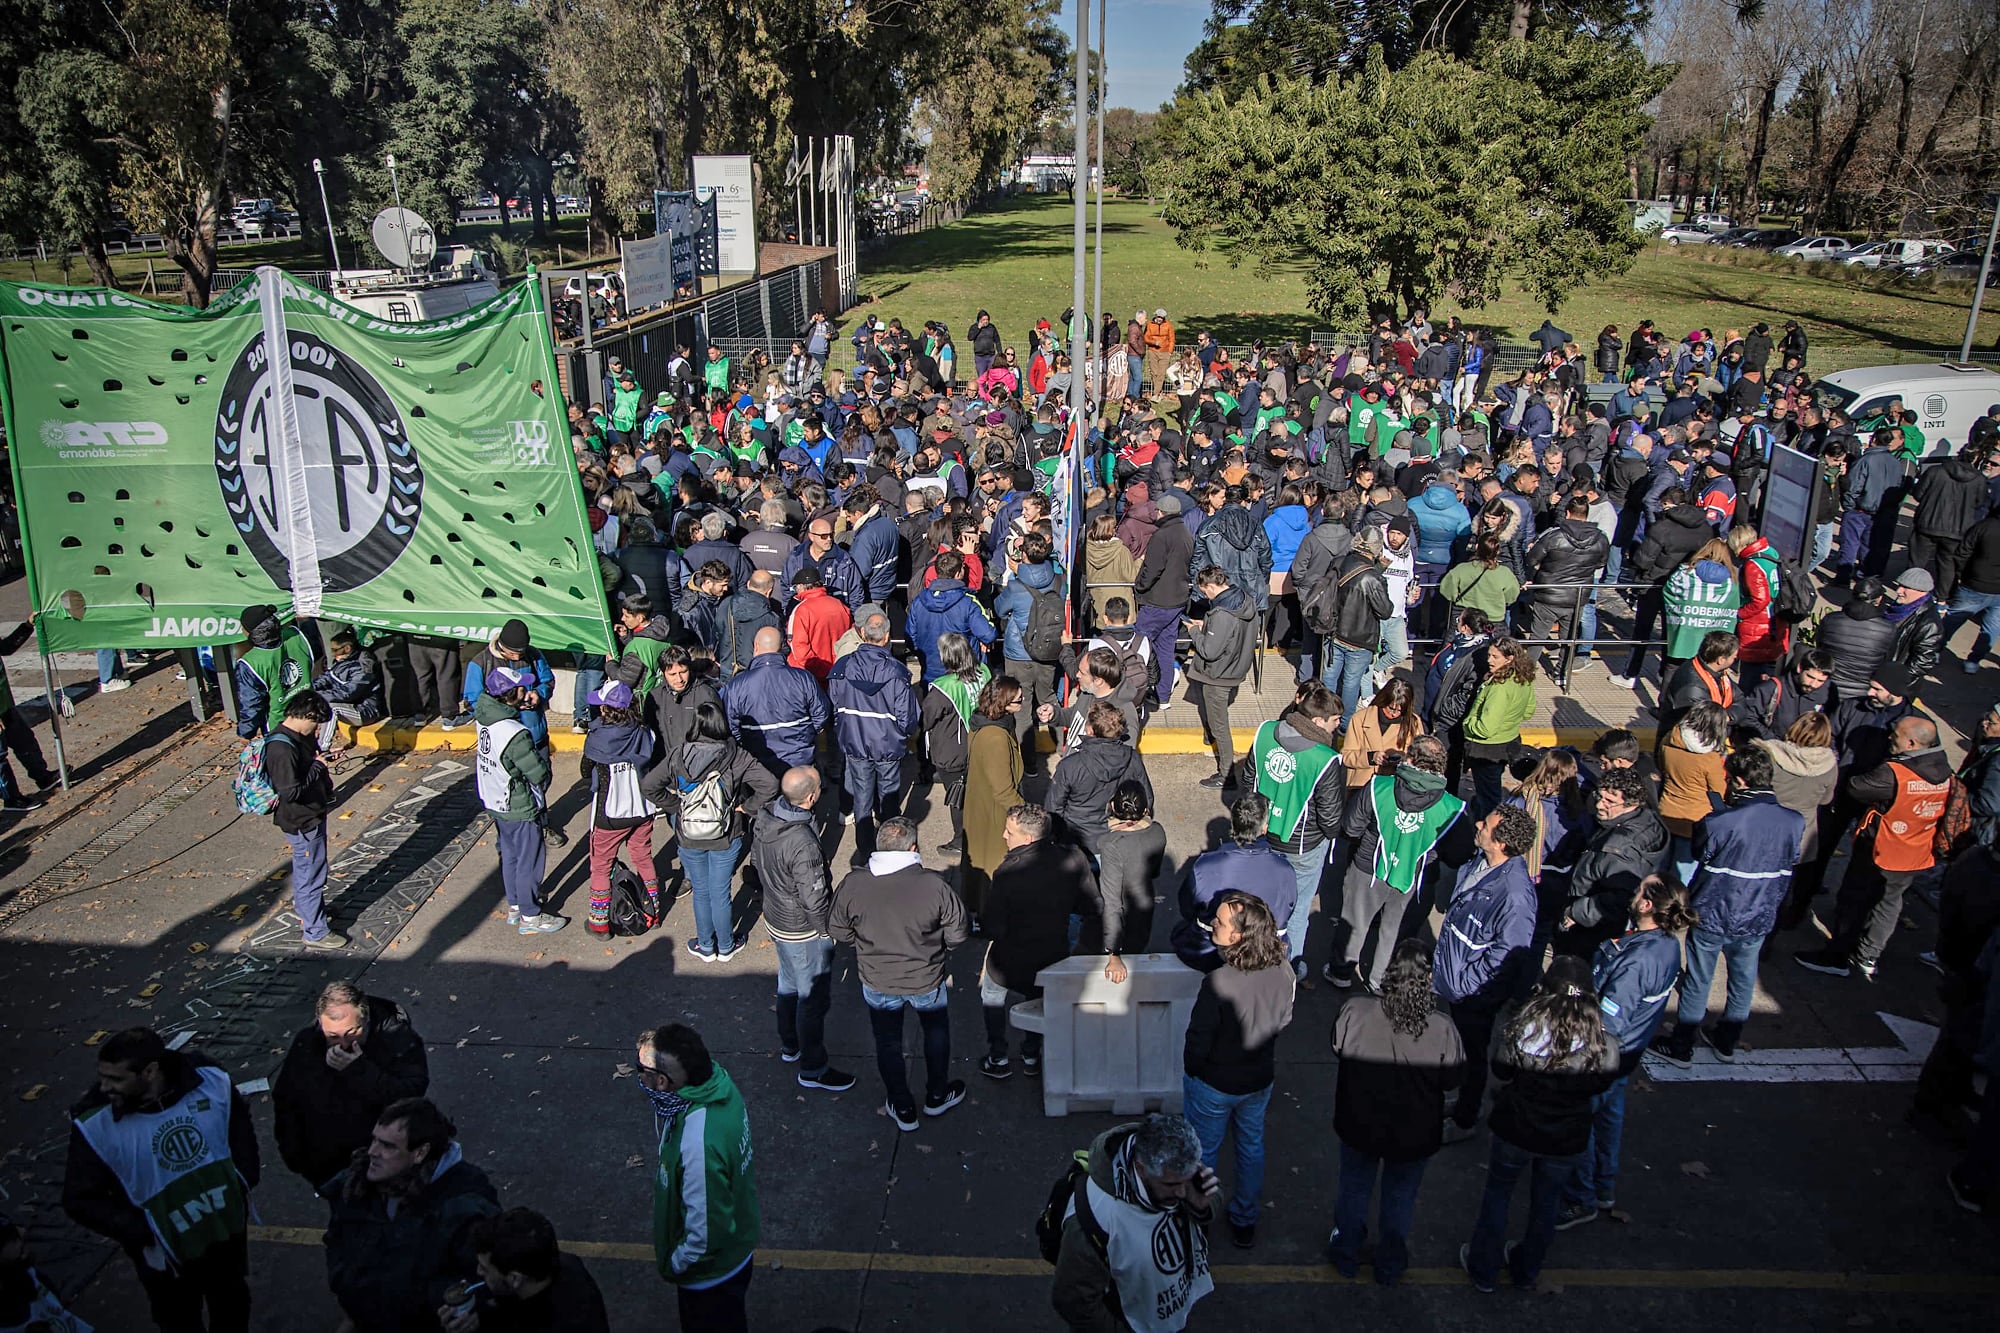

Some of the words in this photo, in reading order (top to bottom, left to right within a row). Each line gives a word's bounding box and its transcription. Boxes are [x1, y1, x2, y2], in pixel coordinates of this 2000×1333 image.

[707, 185, 725, 193] INTI
[1923, 420, 1945, 428] INTI
[164, 1128, 200, 1161] ATE
[1156, 1284, 1178, 1306] ATE
